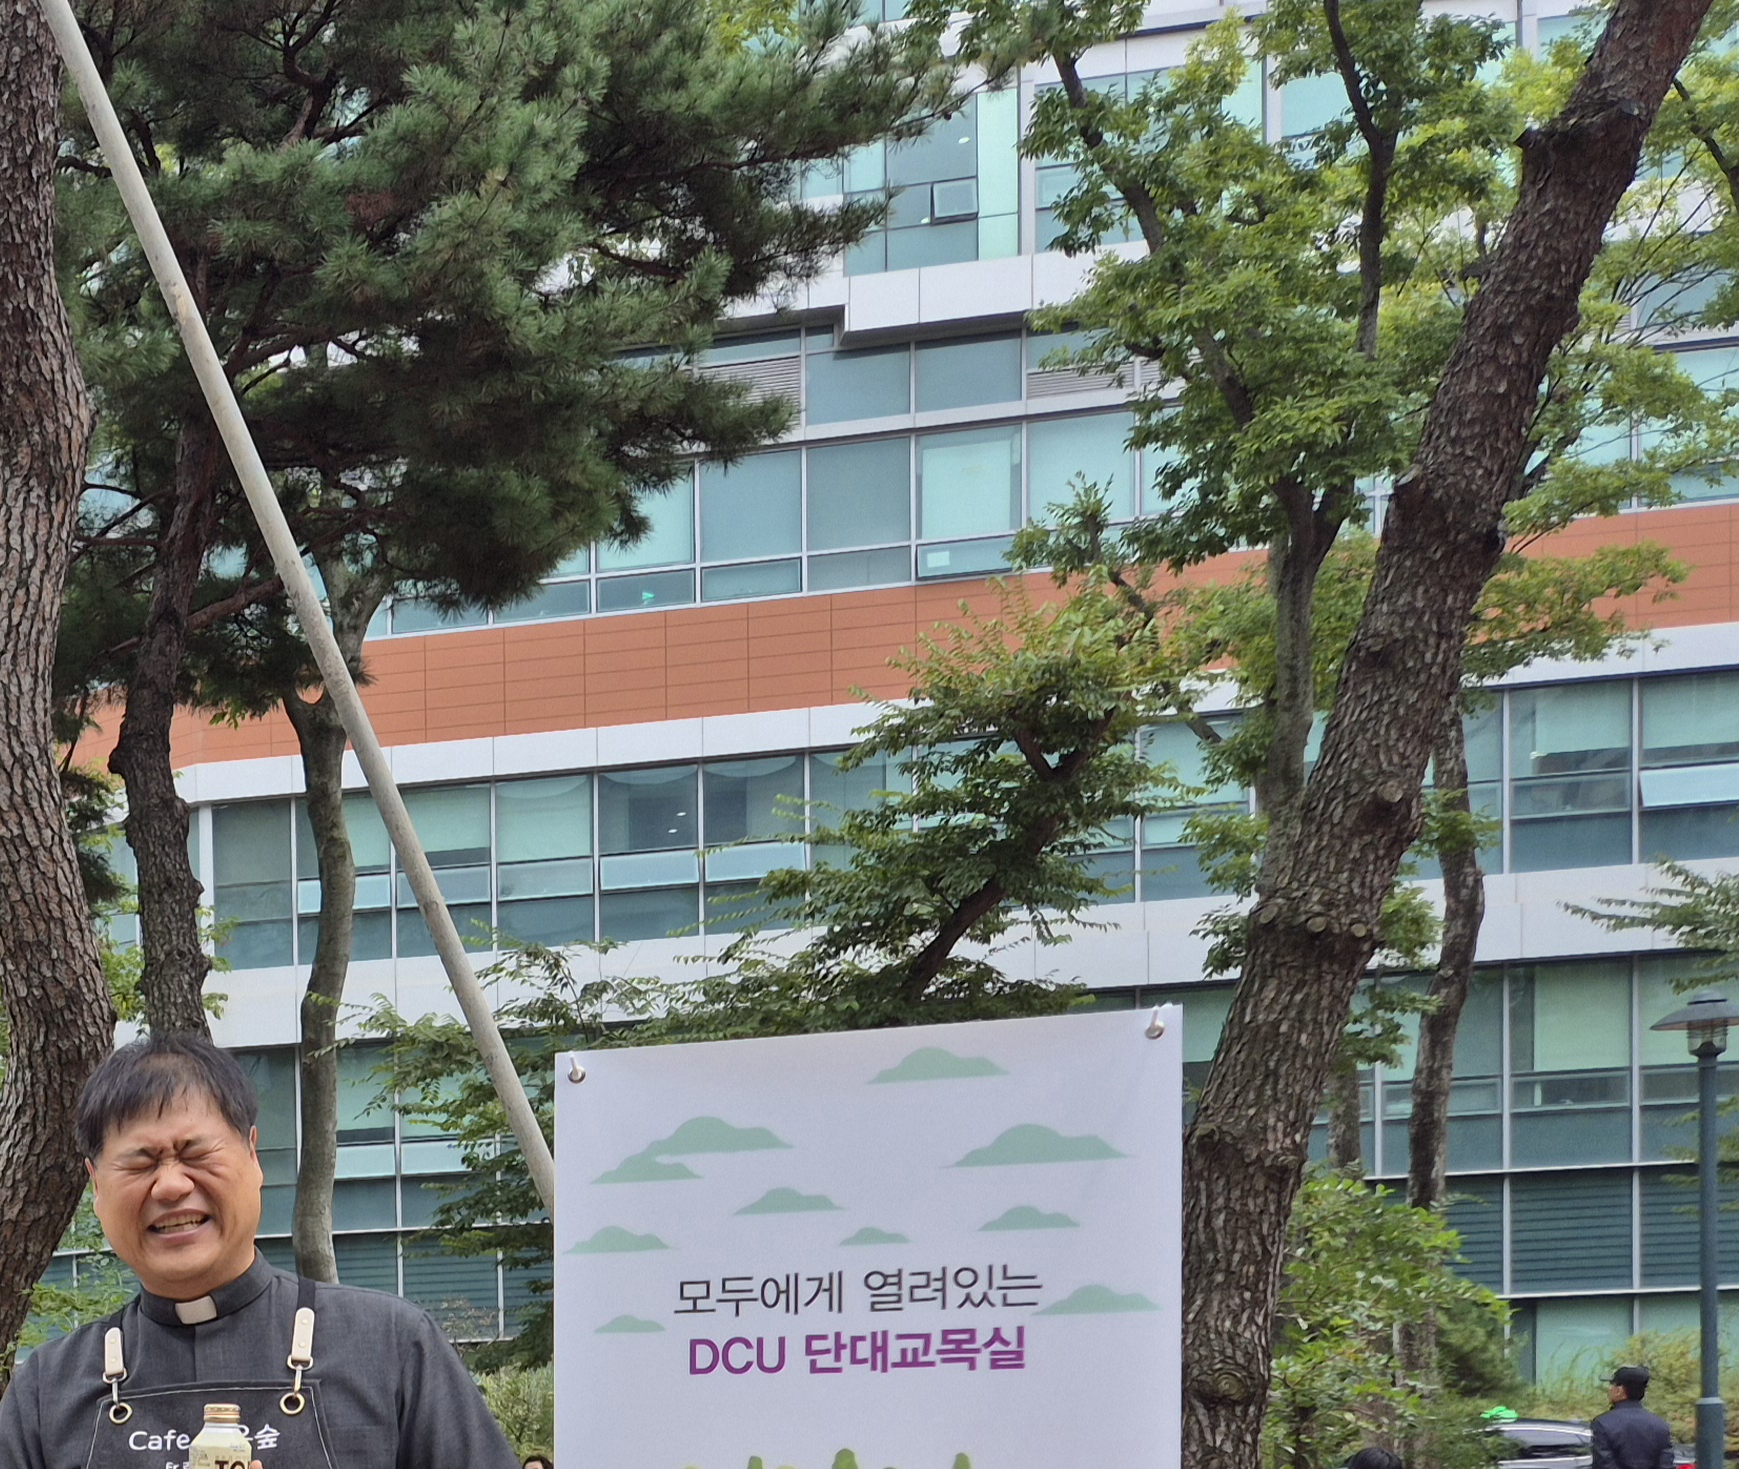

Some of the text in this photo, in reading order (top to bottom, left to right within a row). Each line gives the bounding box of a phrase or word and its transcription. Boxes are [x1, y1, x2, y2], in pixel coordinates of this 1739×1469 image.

[674, 1264, 1043, 1316] 모두에게 열려있는
[688, 1325, 1026, 1375] DCU 단대교목실
[129, 1430, 190, 1451] Cafe
